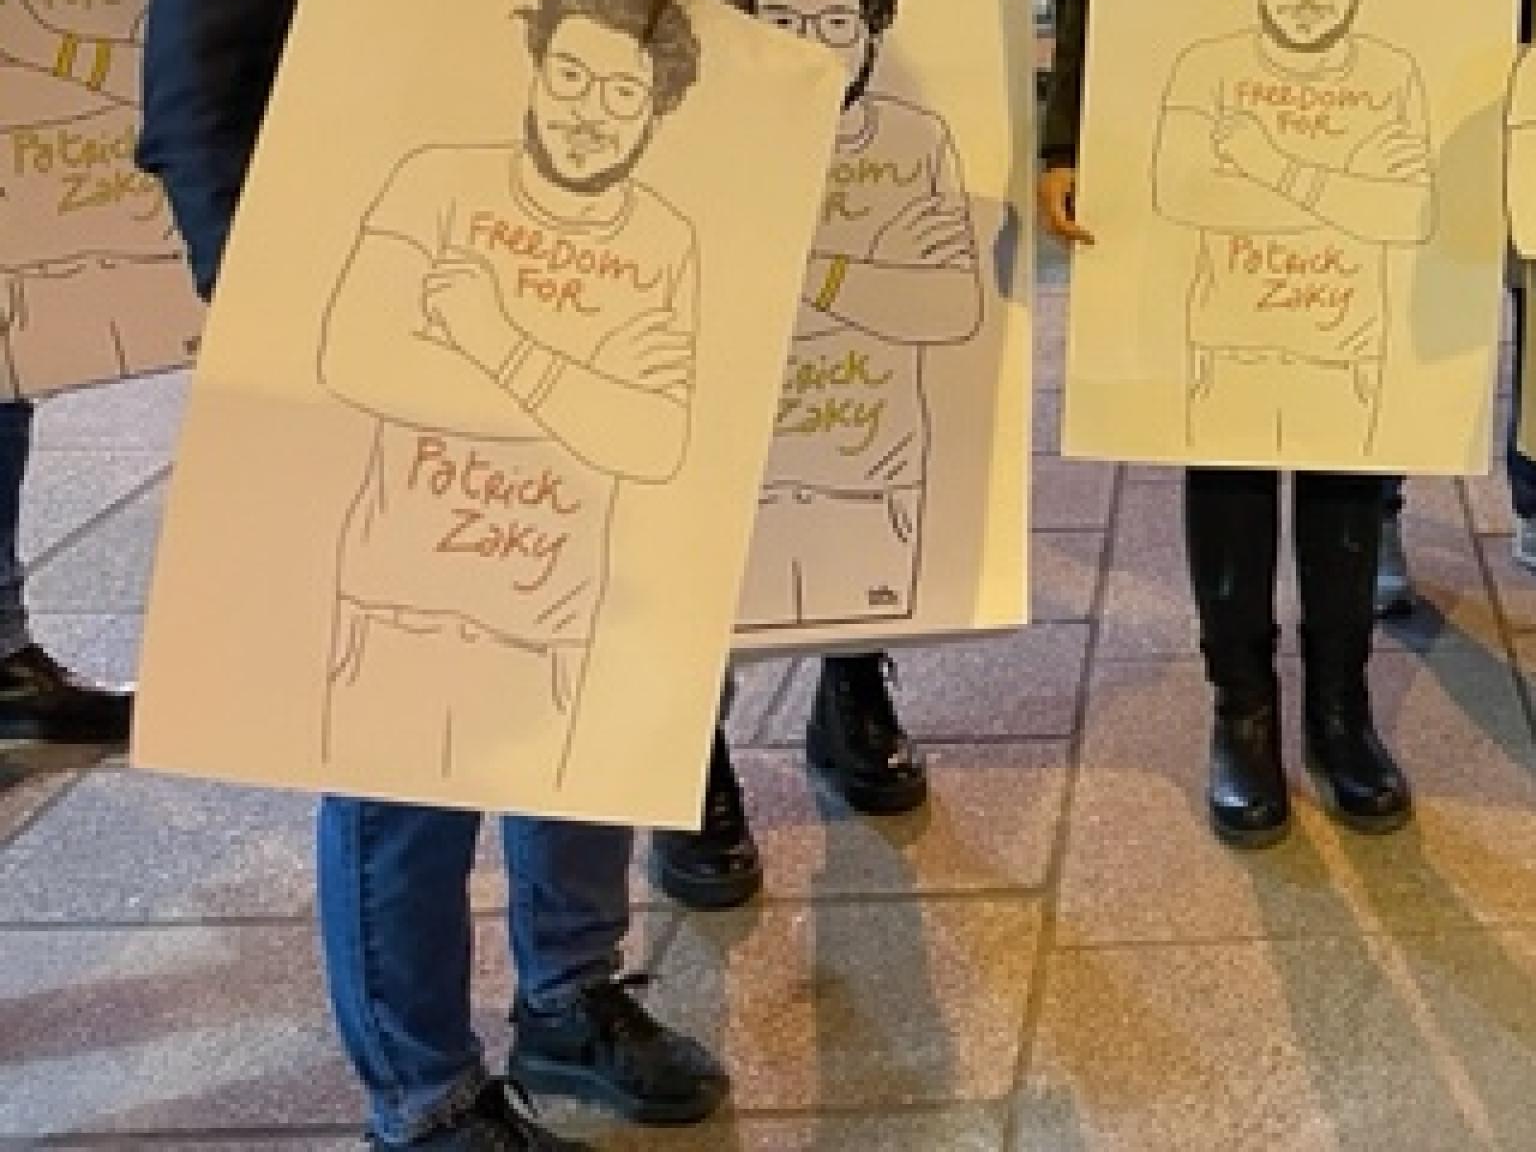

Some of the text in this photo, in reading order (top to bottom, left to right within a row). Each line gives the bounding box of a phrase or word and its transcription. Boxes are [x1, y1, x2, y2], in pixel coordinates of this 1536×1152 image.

[1227, 234, 1364, 275] Patrick
[1254, 277, 1355, 332] Zaky
[406, 436, 582, 514] Patrick
[432, 508, 571, 593] Zaky
